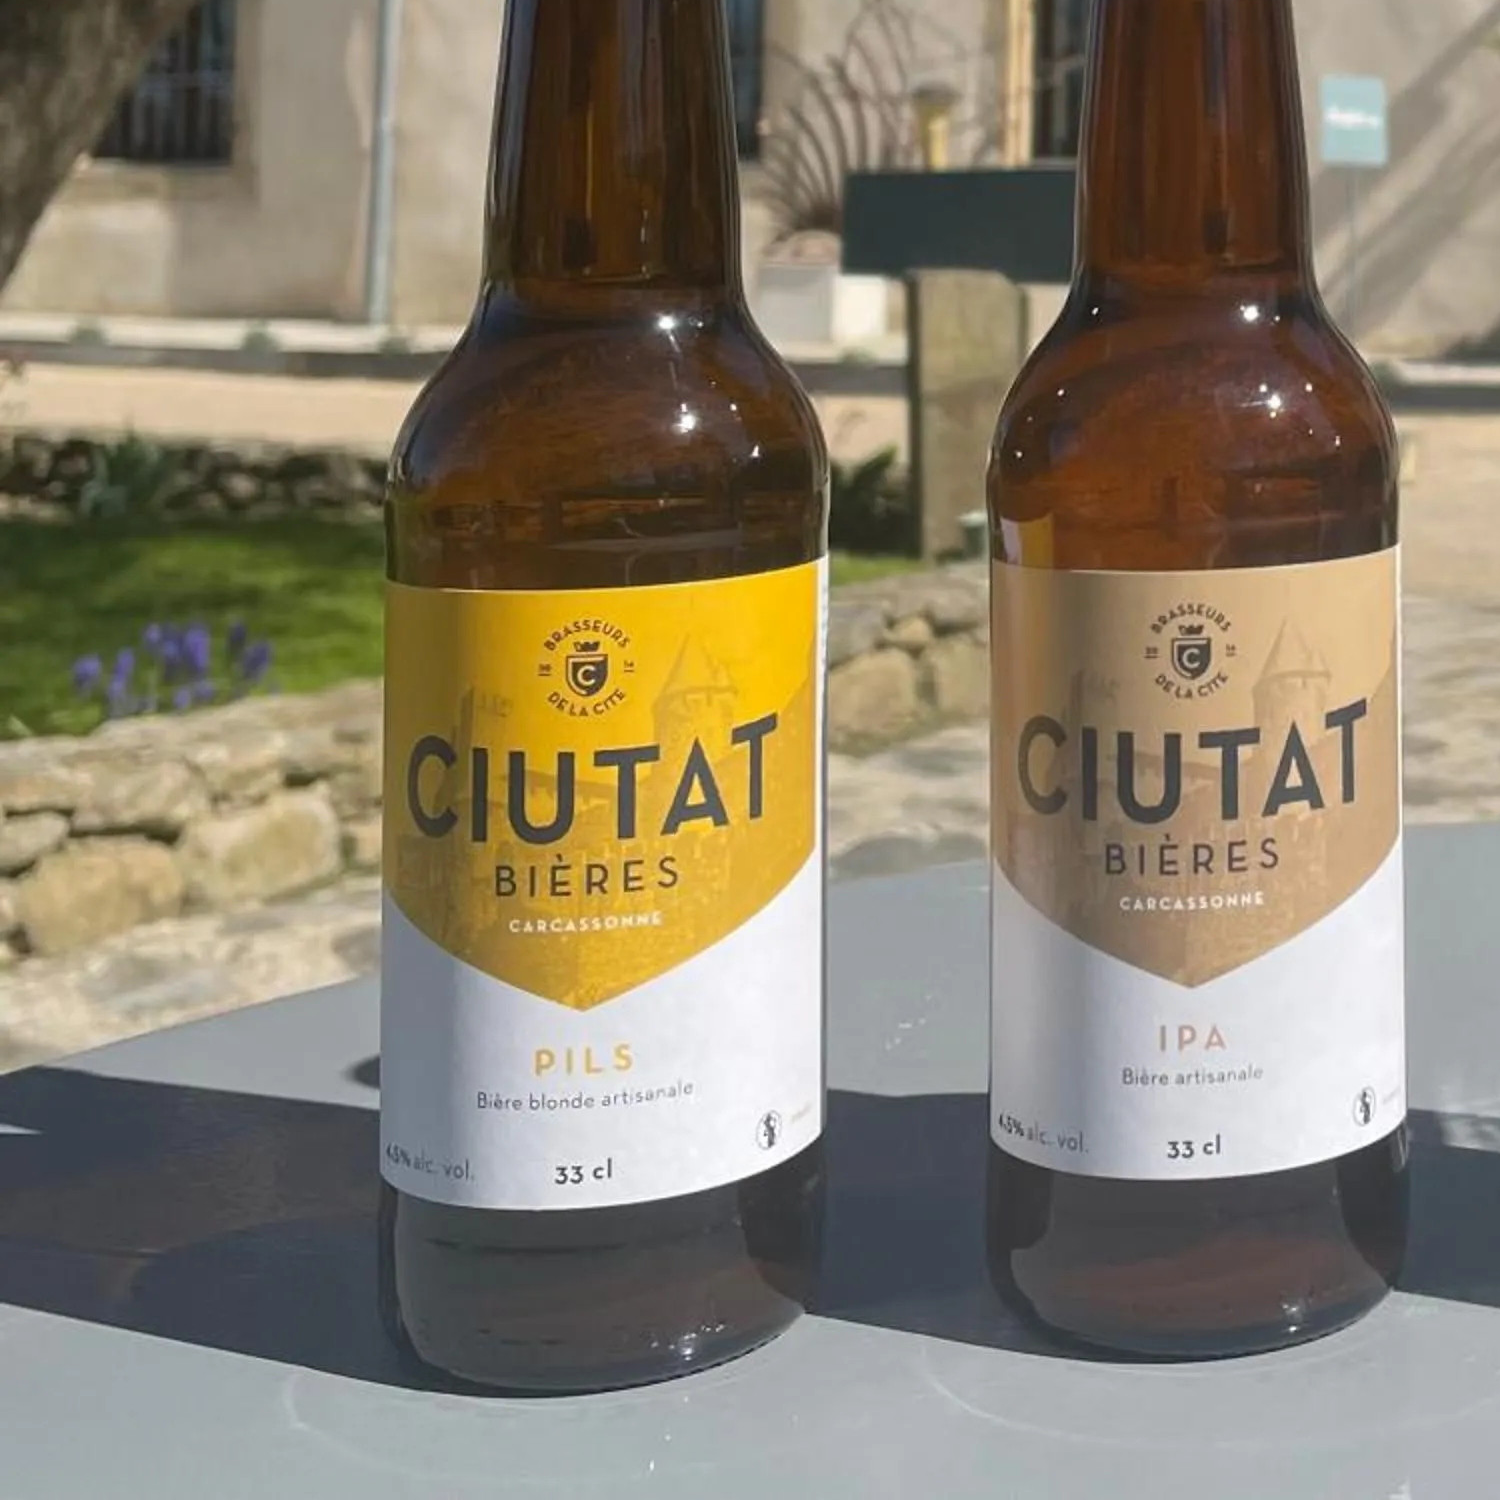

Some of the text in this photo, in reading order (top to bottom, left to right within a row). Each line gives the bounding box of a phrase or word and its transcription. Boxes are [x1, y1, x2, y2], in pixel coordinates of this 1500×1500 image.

[544, 619, 630, 651] BRASSEURS
[547, 691, 569, 712] DE
[569, 703, 589, 717] LA
[1017, 698, 1368, 825] CIUTAT
[408, 713, 778, 844] CIUTAT
[1104, 832, 1280, 877] BIÈRES
[494, 853, 678, 898] BIÈRES
[1119, 891, 1265, 912] CARCASSONNE
[508, 912, 663, 934] CARCASSONNE
[1159, 1024, 1227, 1052] IPA
[534, 1044, 633, 1077] PILS
[1121, 1063, 1263, 1086] Bière artisanale
[477, 1078, 694, 1111] Bière blonde artisanale
[1057, 1131, 1090, 1154] vol.
[1167, 1133, 1221, 1160] 33 cl
[555, 1156, 613, 1185] 33 cl
